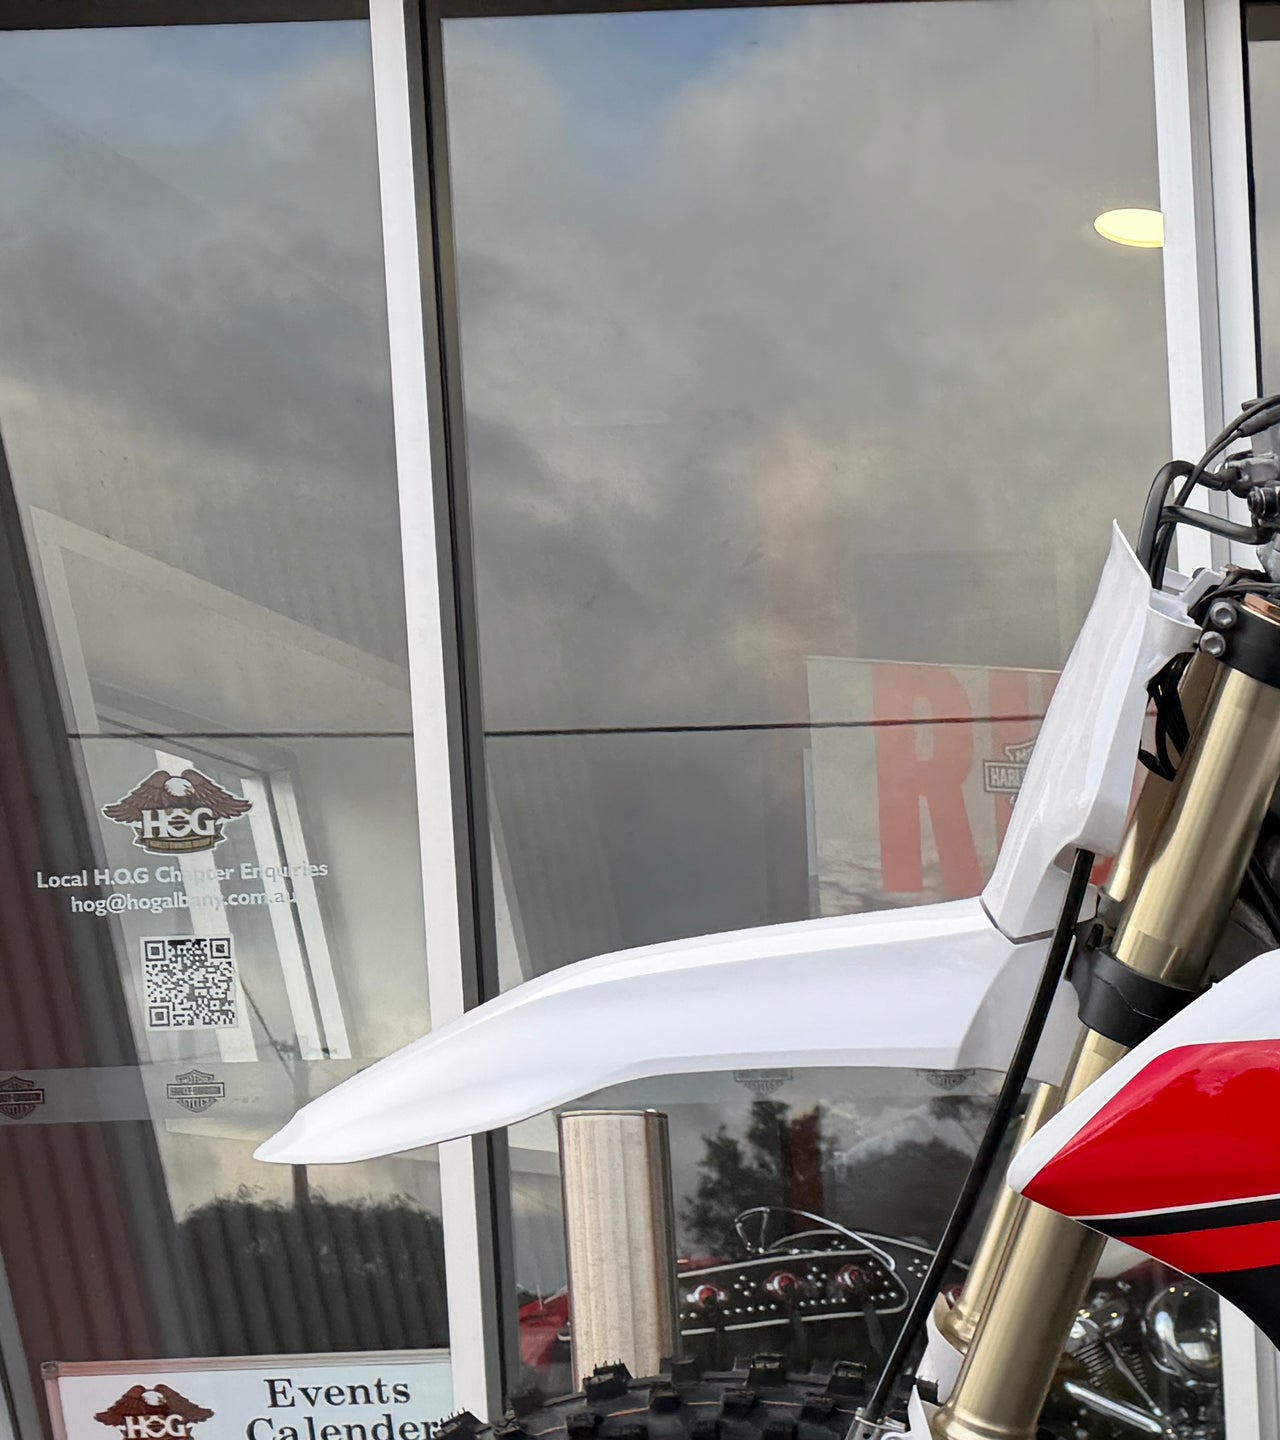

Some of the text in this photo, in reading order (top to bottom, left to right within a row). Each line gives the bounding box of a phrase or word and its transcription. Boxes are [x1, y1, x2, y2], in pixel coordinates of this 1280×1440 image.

[37, 870, 87, 889] Local
[94, 867, 149, 886] H.O.G
[264, 1377, 411, 1408] Events
